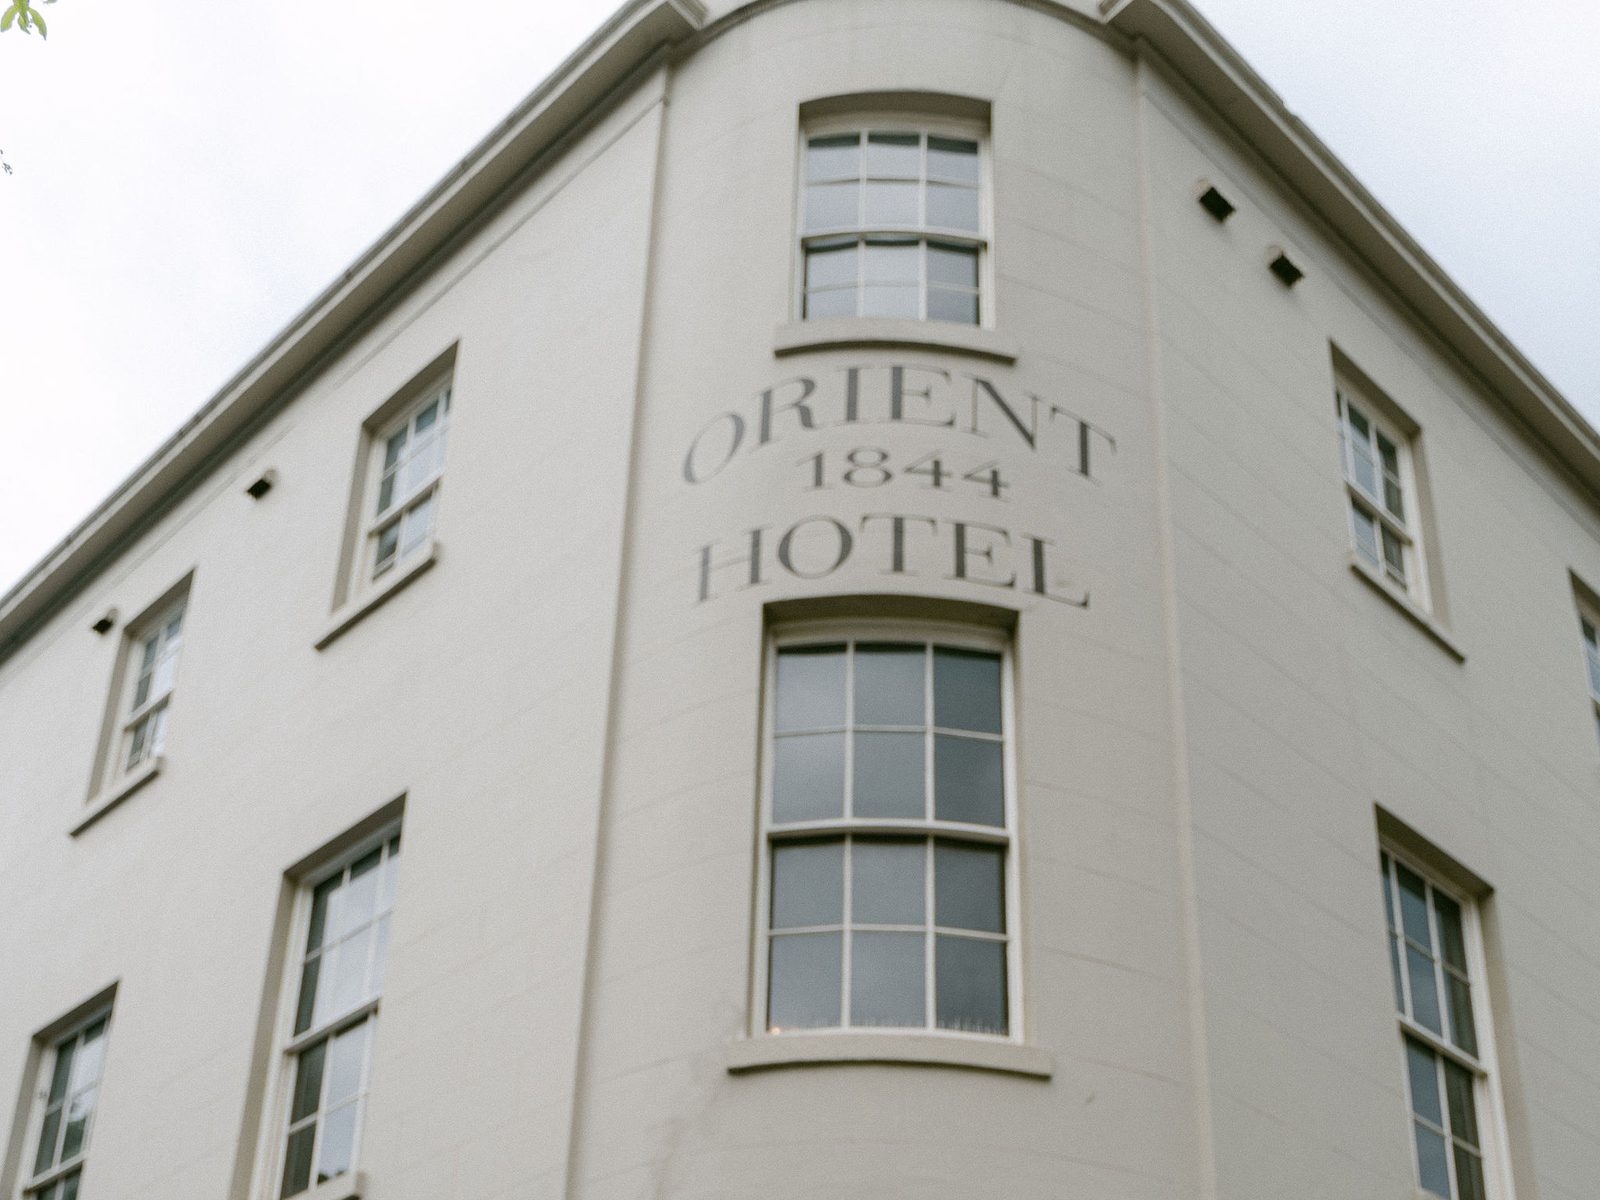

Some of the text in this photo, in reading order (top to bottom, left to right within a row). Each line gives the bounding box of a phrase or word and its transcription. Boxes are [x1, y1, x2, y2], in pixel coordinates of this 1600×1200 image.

[682, 364, 1118, 485] ORIENT
[797, 446, 1010, 498] 1844
[692, 513, 1091, 610] HOTEL
